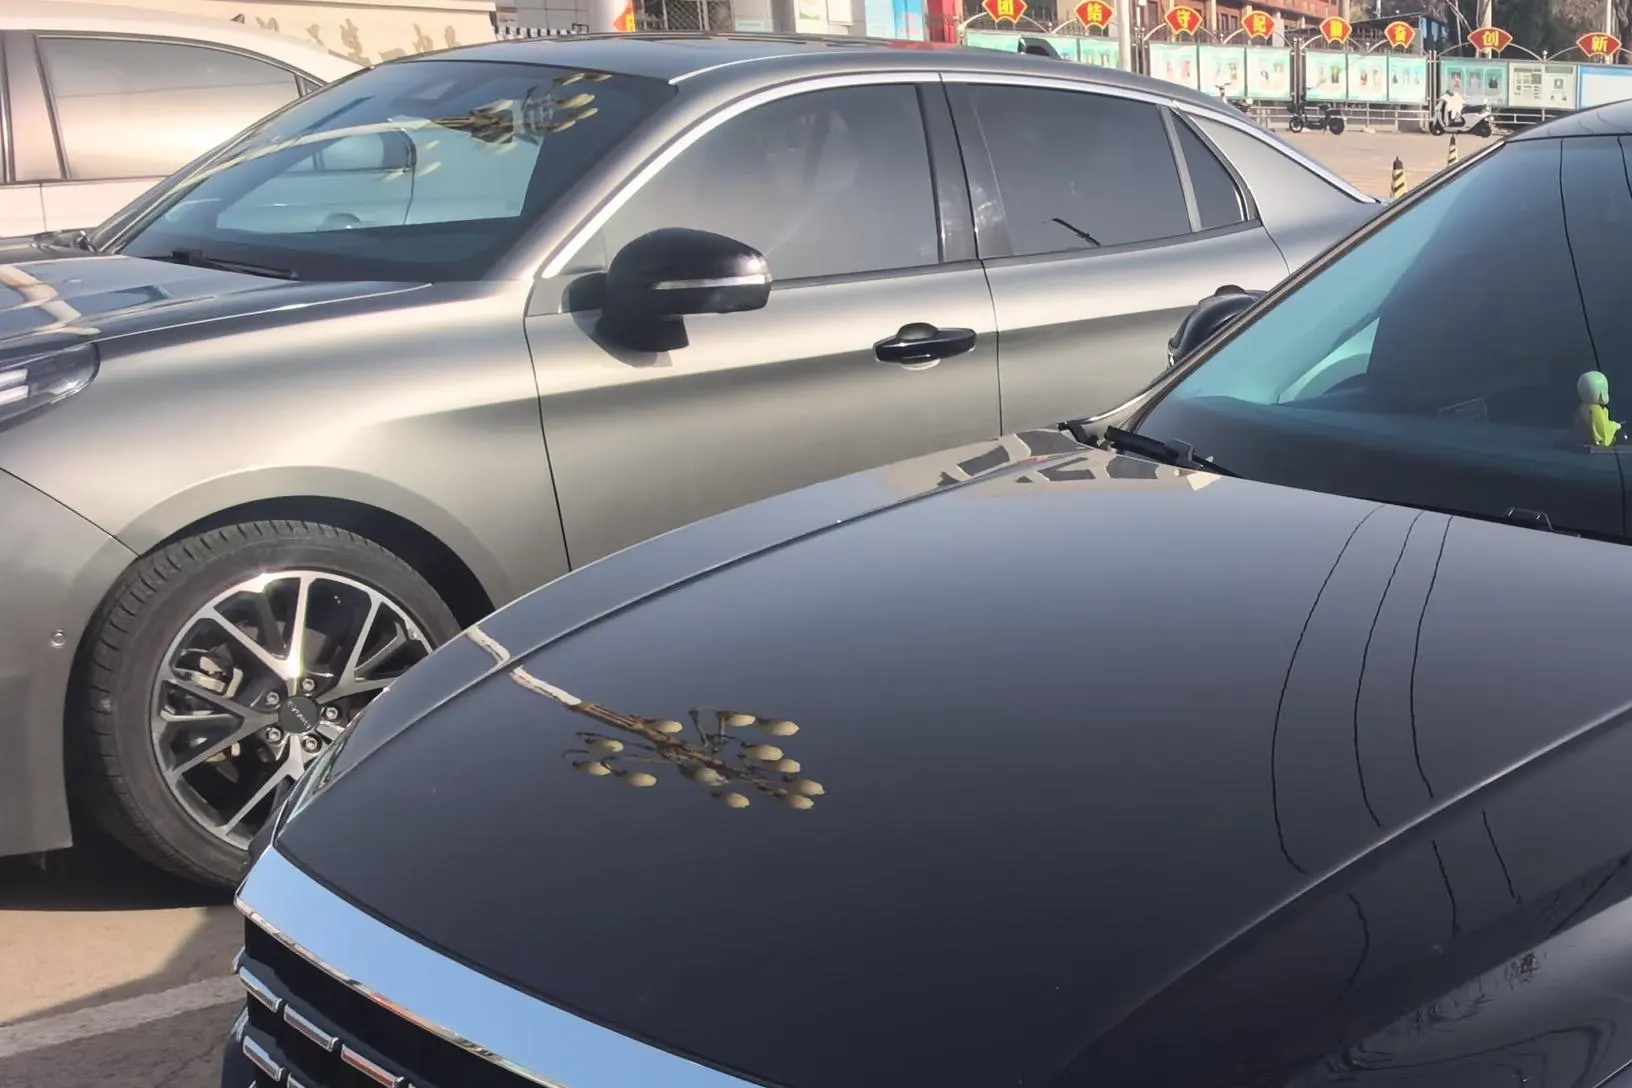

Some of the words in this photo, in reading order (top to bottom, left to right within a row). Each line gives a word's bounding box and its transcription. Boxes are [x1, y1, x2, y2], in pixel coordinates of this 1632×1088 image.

[1176, 9, 1191, 28] 守
[1482, 30, 1499, 46] 创
[1591, 36, 1608, 52] 新
